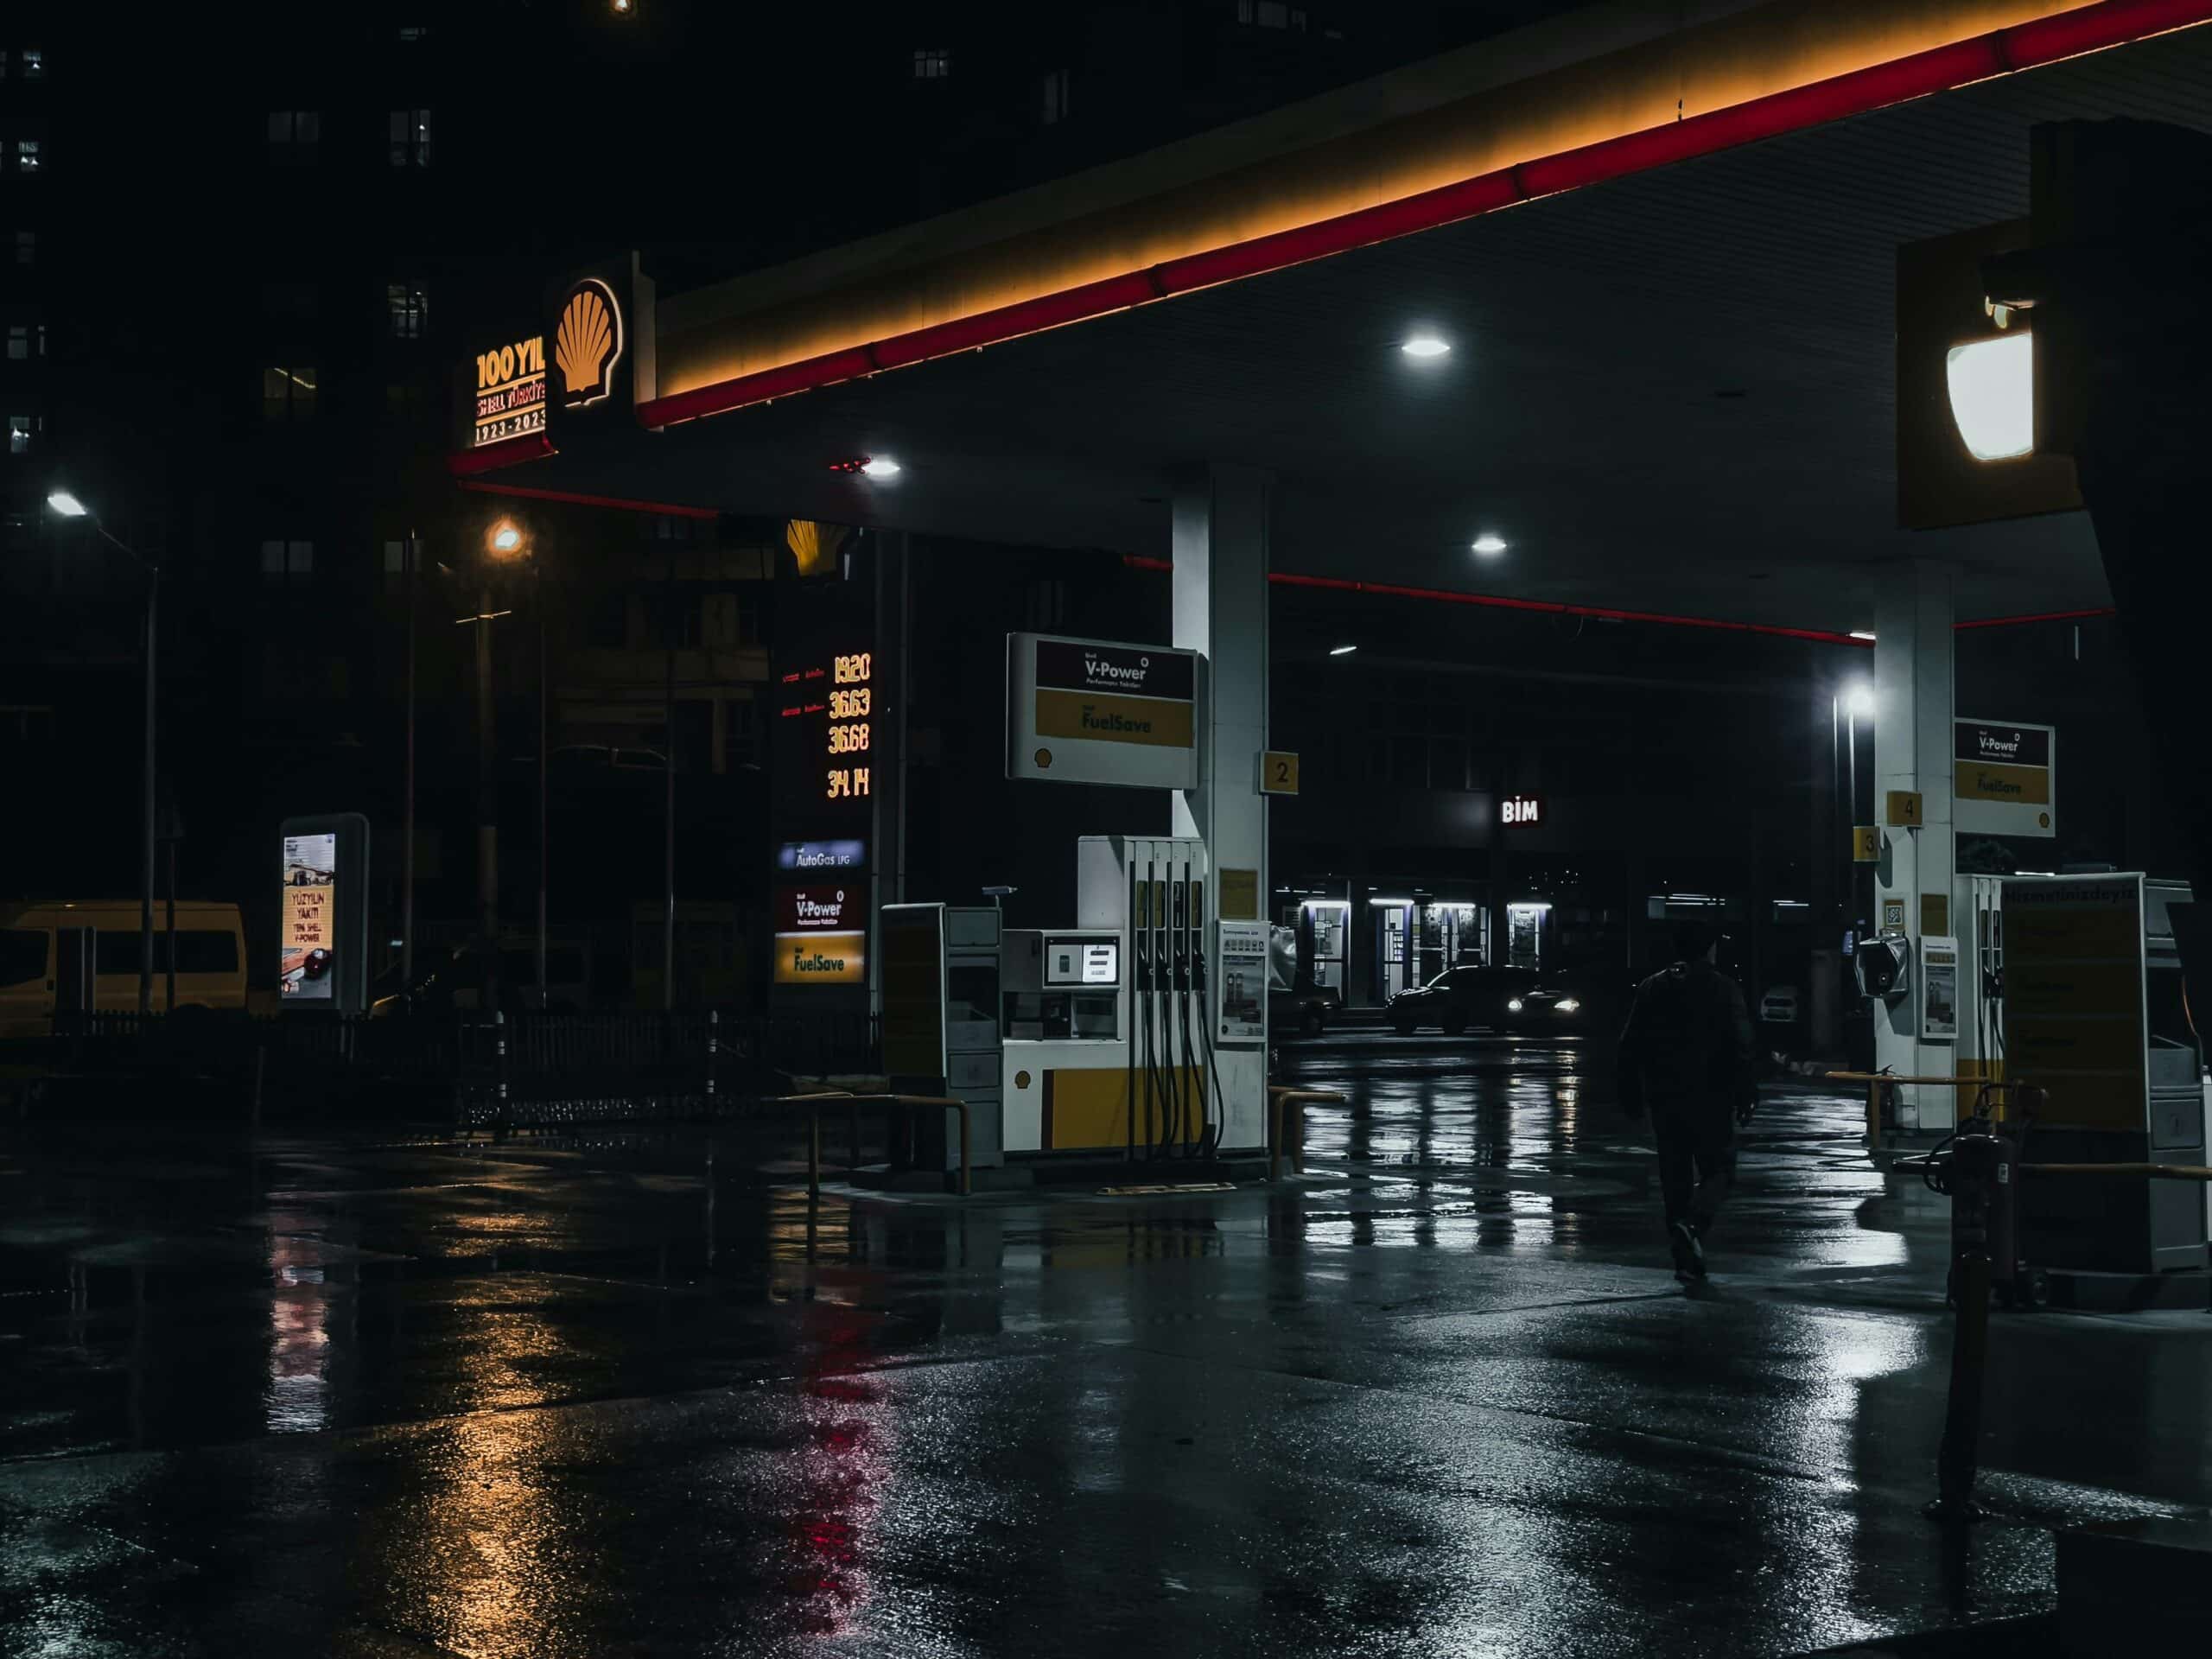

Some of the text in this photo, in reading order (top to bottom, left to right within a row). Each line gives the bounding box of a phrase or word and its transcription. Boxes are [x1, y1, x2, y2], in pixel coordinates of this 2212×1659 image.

[477, 336, 545, 387] 100 YIL
[1085, 660, 1147, 681] V-Power
[1082, 713, 1152, 733] FuelSave
[1979, 735, 2018, 753] V-Power
[1277, 762, 1288, 782] 2
[1503, 795, 1538, 823] BİM
[1905, 798, 1914, 817] 4
[1866, 834, 1875, 852] 3
[796, 852, 835, 867] AutoGas
[796, 900, 842, 918] V-Power
[794, 953, 844, 972] FuelSave
